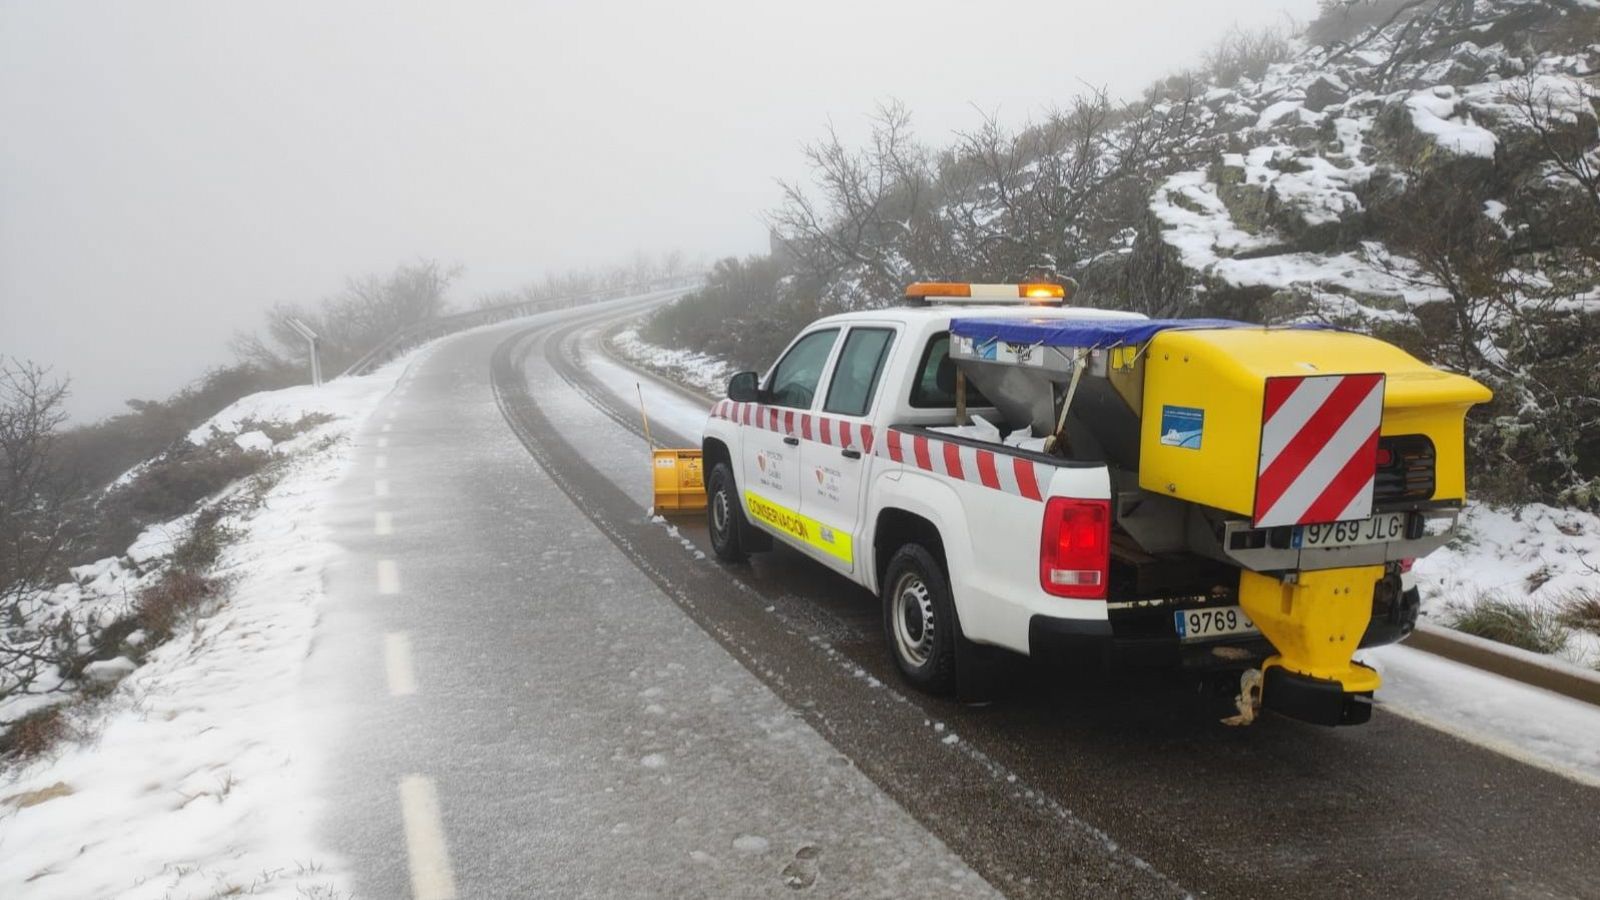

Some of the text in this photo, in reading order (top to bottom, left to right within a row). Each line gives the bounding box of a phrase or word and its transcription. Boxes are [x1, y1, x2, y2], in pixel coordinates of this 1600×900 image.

[1308, 515, 1400, 544] 9769 JLG
[1189, 609, 1237, 634] 9769
